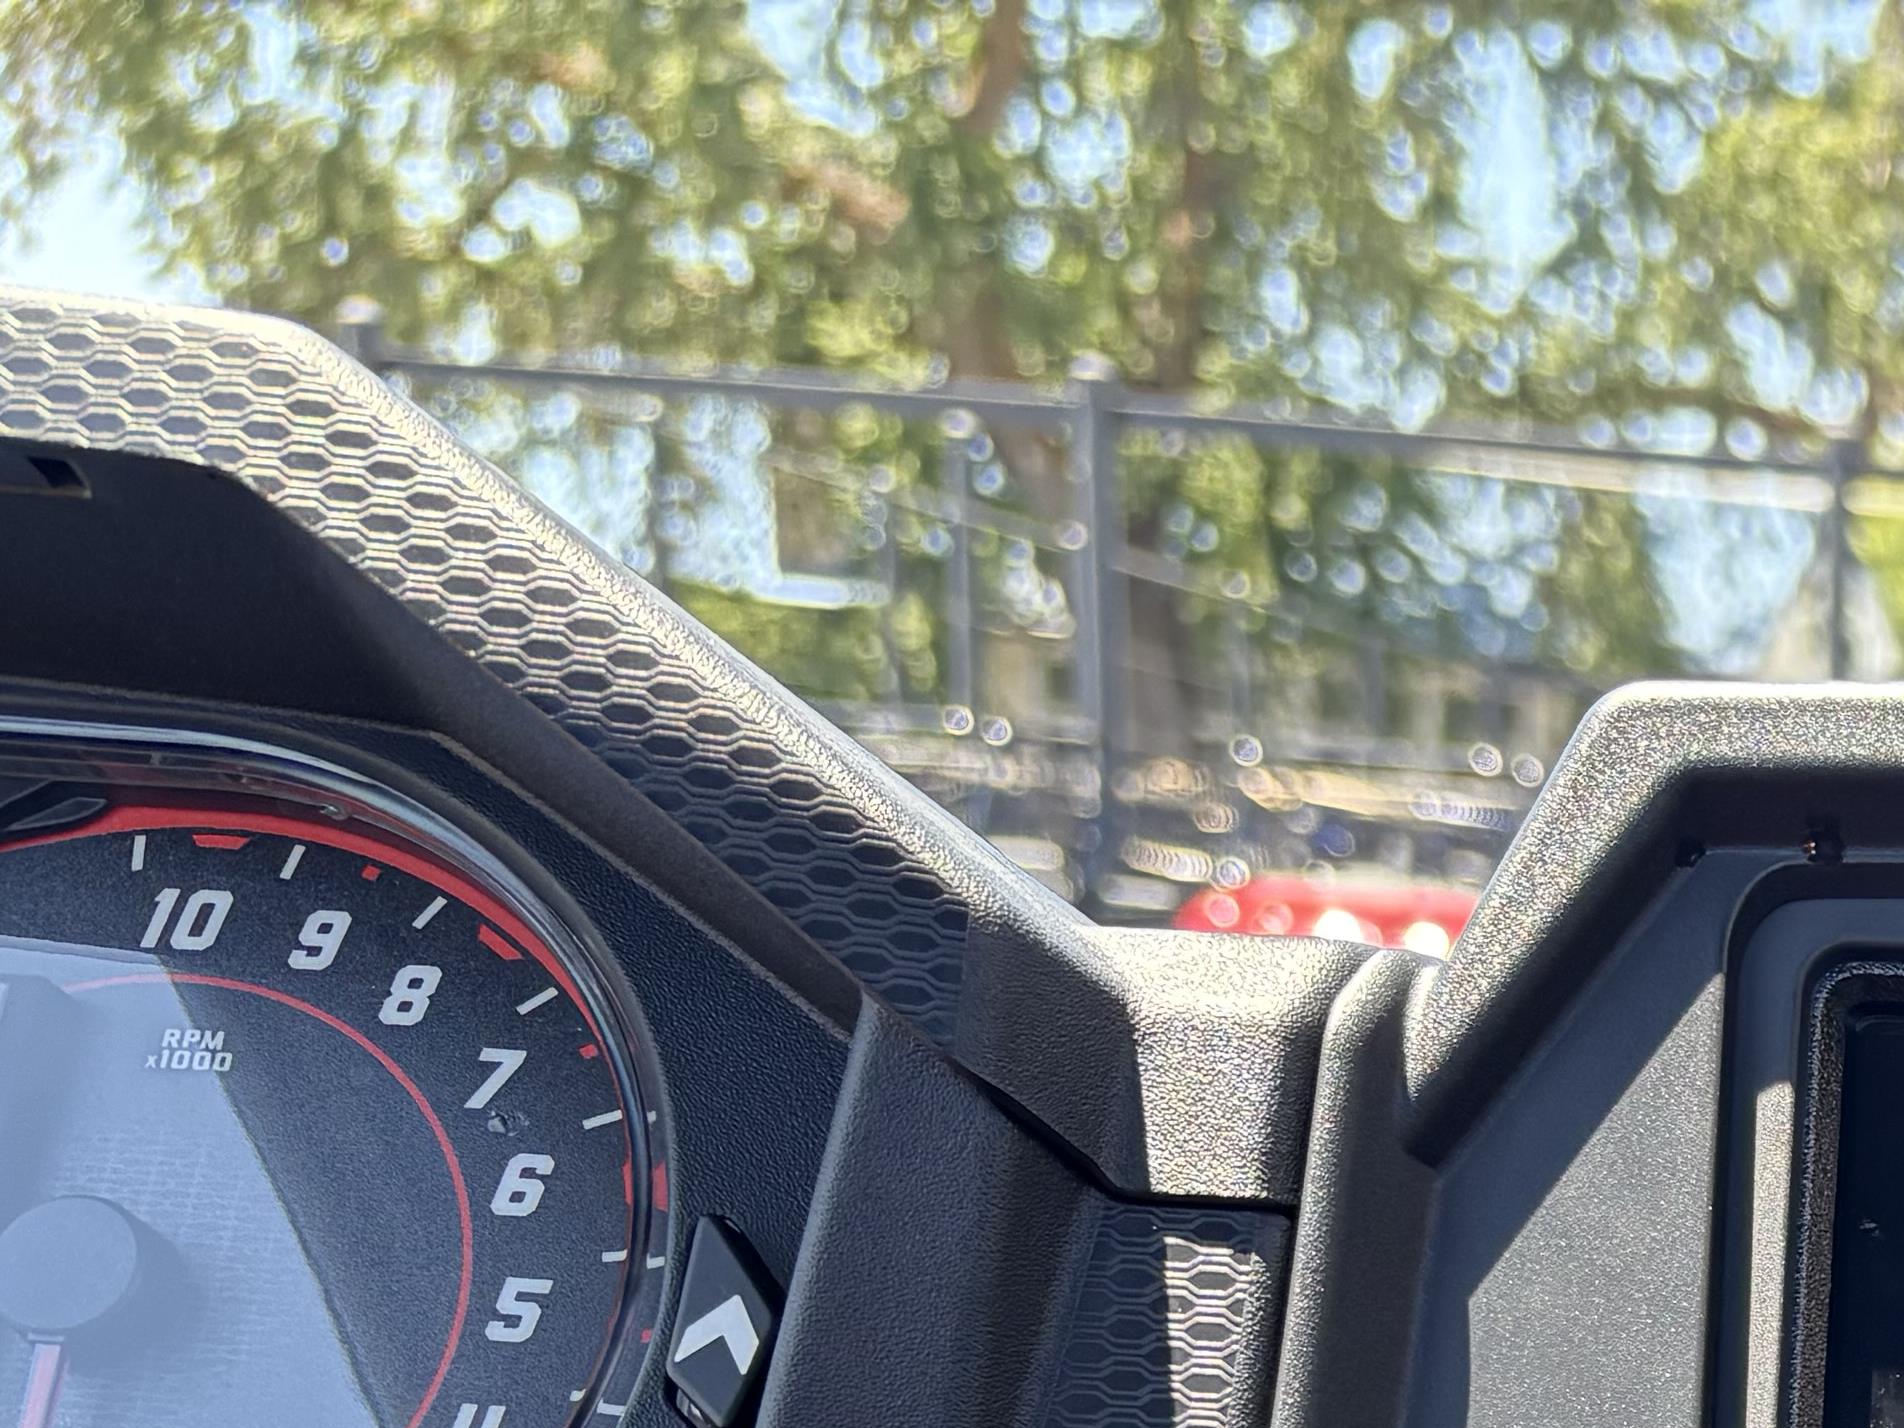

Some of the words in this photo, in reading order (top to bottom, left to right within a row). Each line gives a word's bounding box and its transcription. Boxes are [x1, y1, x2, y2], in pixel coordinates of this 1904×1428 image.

[140, 888, 234, 951] 10
[288, 910, 352, 971] 9
[379, 964, 443, 1026] 8
[143, 1049, 233, 1072] x1000
[161, 1028, 225, 1050] RPM
[464, 1048, 527, 1109] 7
[491, 1153, 555, 1217] 6
[485, 1278, 554, 1343] 5
